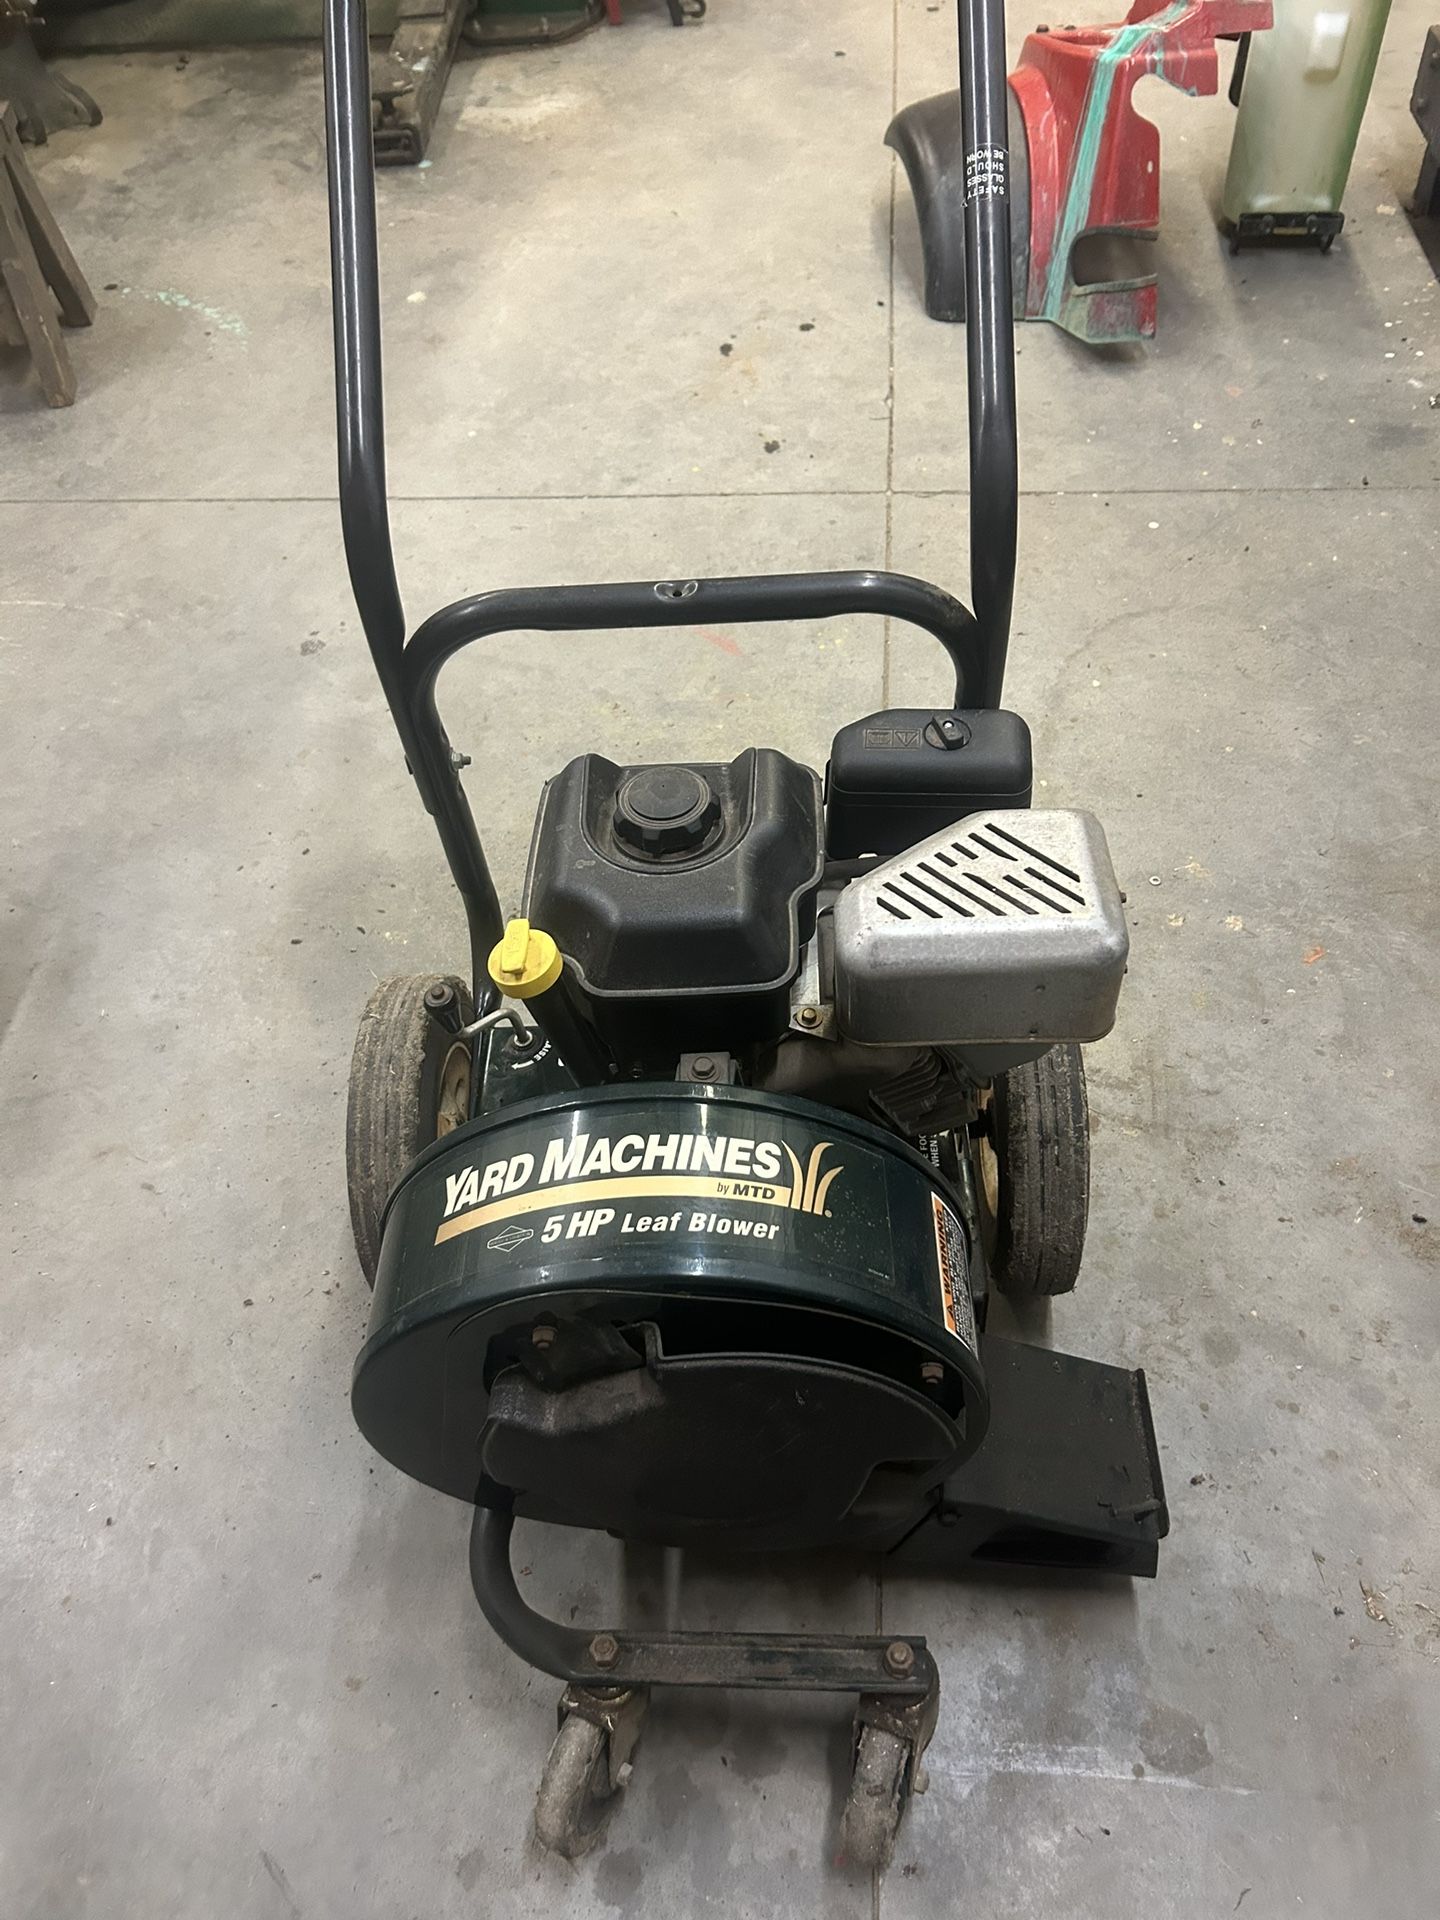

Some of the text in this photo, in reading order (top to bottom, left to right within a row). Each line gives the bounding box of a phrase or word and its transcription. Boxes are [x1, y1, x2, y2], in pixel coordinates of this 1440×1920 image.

[966, 150, 1004, 164] BE WORN
[967, 162, 1004, 175] SHOULD
[967, 173, 1004, 187] GLASSES
[967, 185, 1004, 200] SAFETY
[533, 1040, 551, 1061] AISE
[930, 1140, 940, 1167] WHEN
[443, 1133, 782, 1217] YARD MACHINES
[716, 1182, 776, 1200] by MTD
[540, 1214, 565, 1244] 5
[565, 1208, 615, 1239] HP
[620, 1212, 682, 1233] Leaf
[688, 1212, 780, 1240] Blower
[936, 1209, 952, 1295] WARNING
